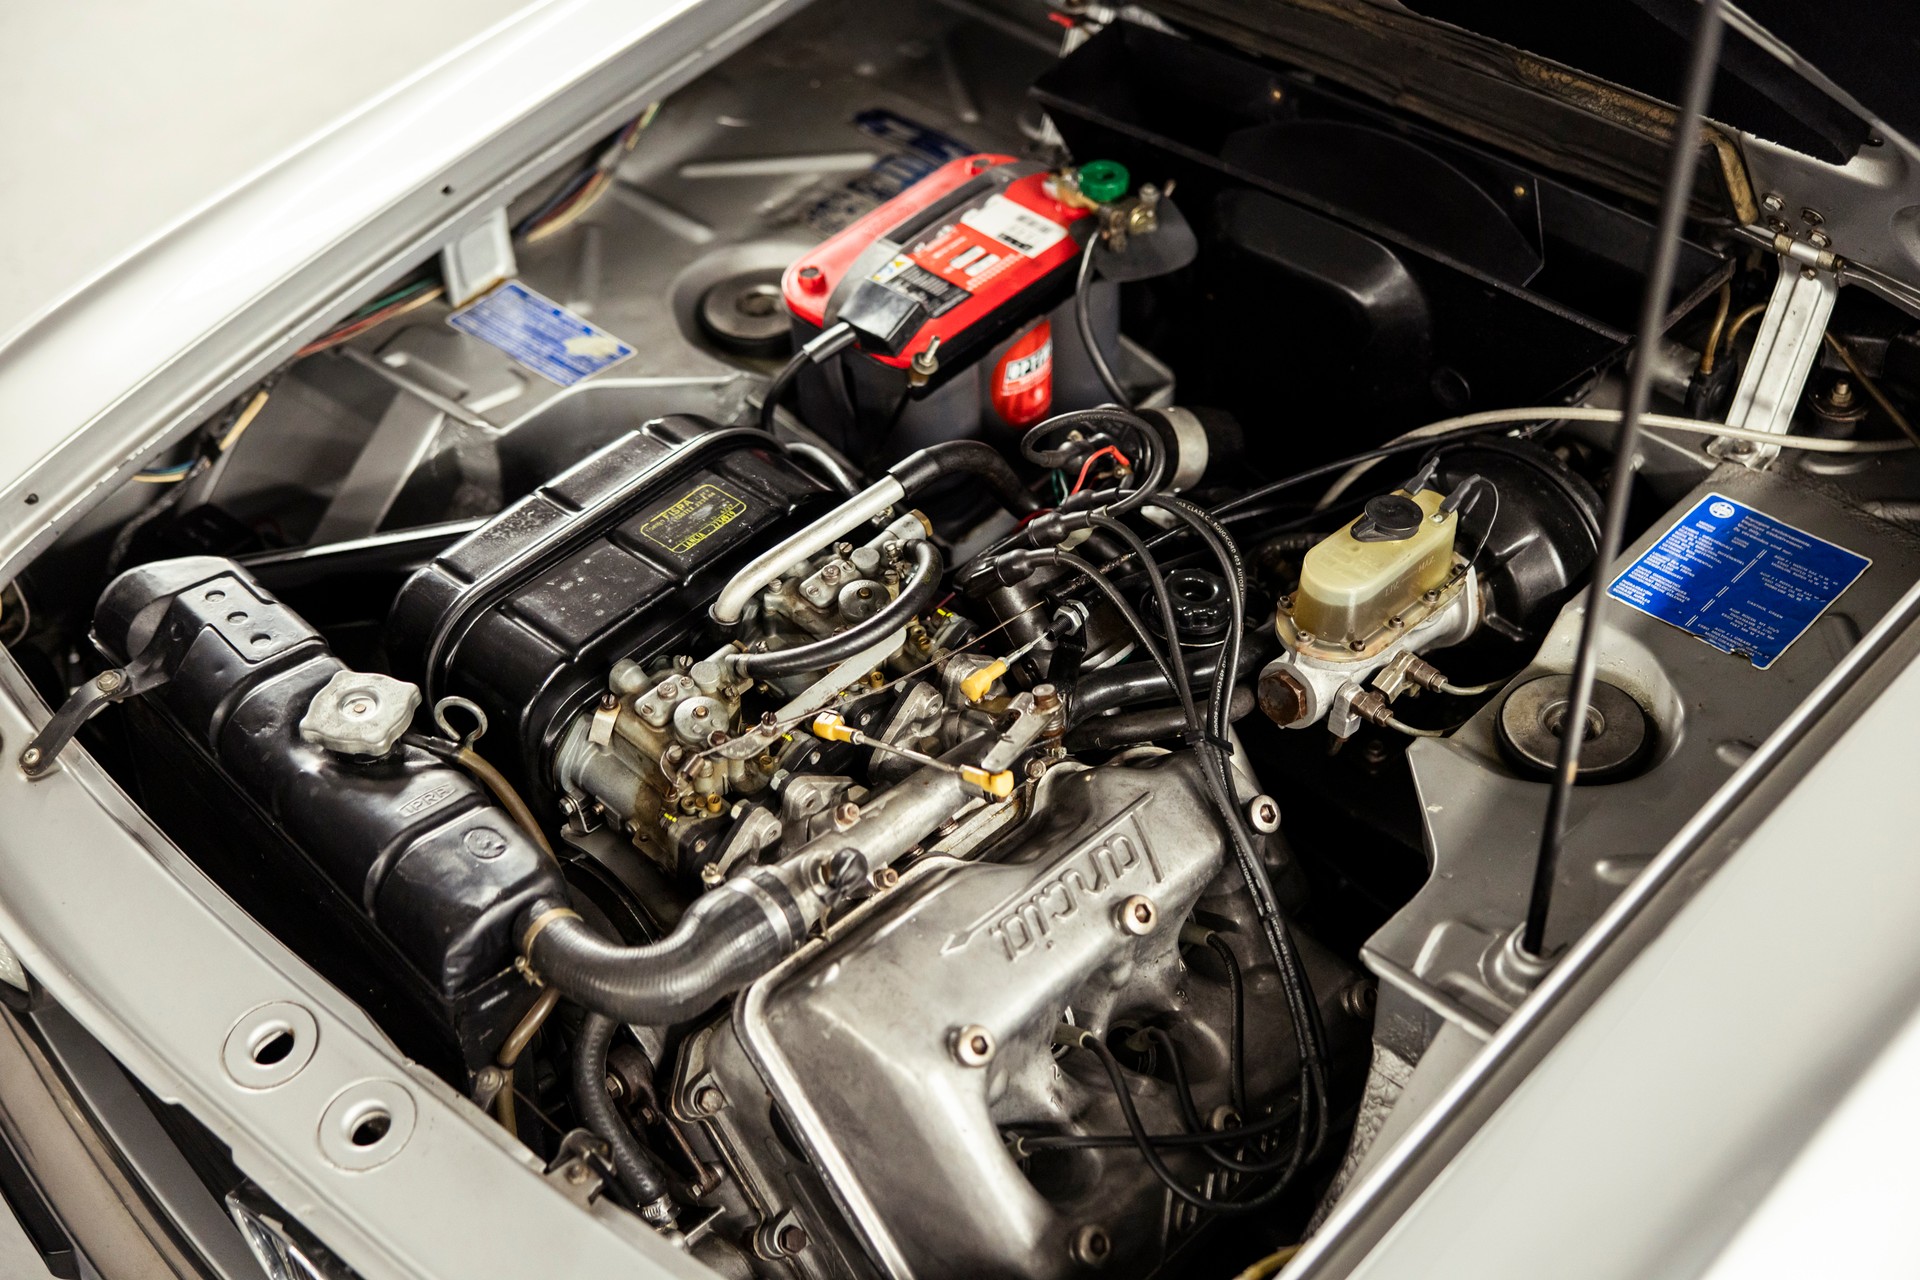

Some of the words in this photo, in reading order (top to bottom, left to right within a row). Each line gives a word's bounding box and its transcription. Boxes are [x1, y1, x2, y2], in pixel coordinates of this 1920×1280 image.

[661, 498, 694, 519] FISPA
[1187, 504, 1205, 518] CLASS
[1239, 859, 1257, 896] AUTORADIO
[1050, 1063, 1062, 1081] 2
